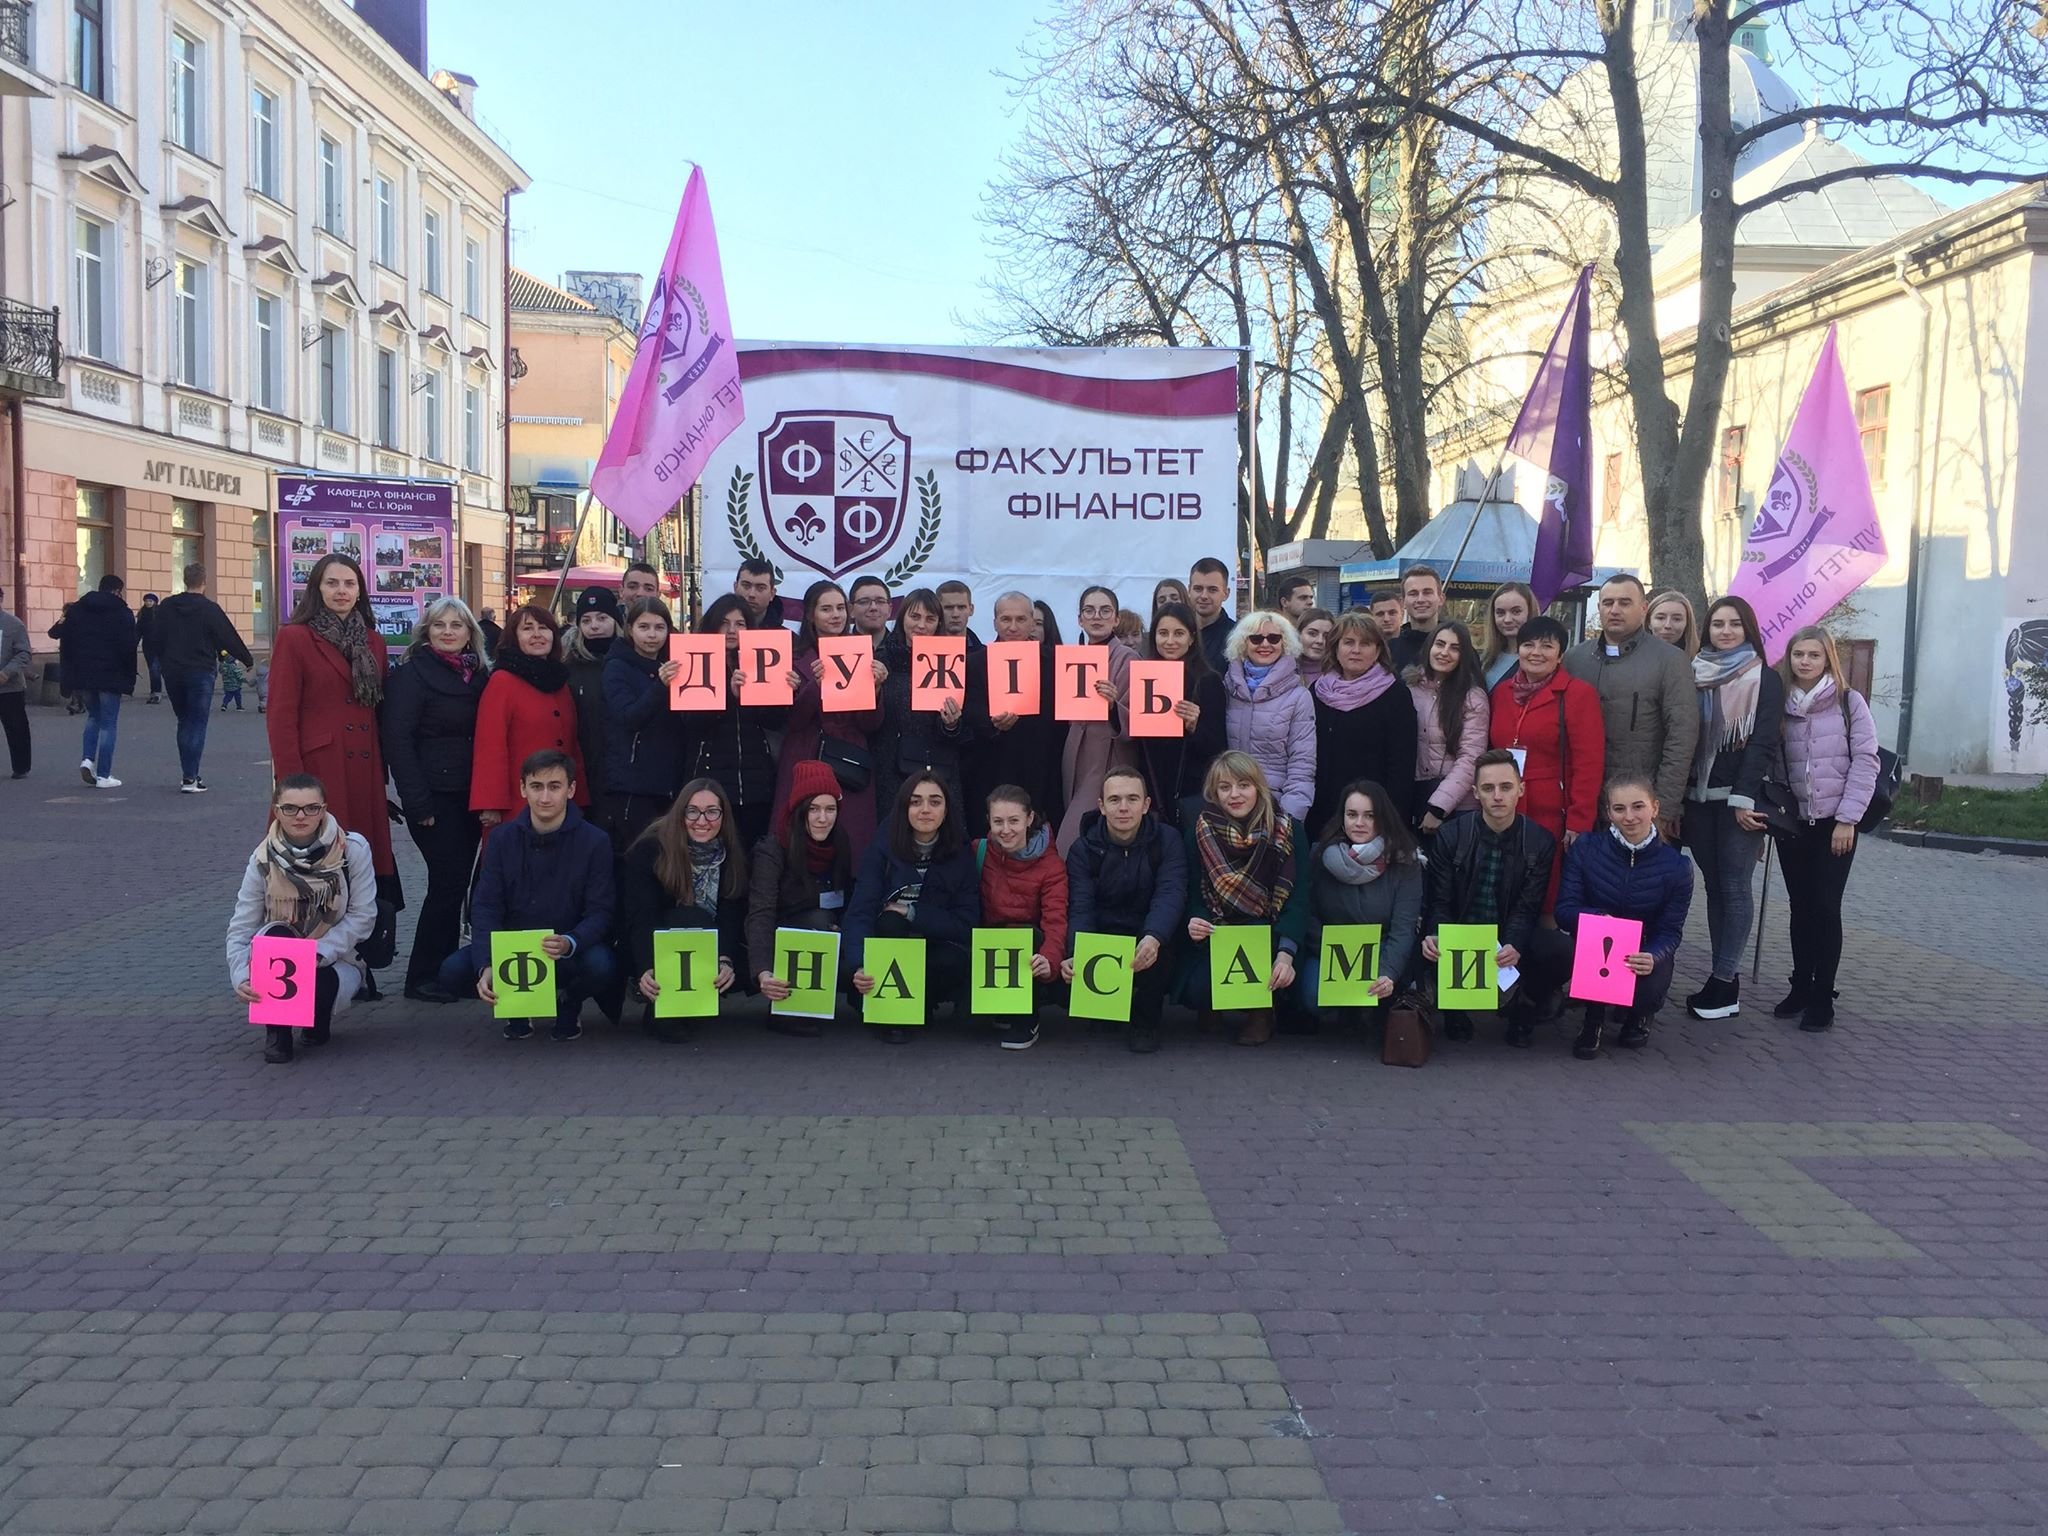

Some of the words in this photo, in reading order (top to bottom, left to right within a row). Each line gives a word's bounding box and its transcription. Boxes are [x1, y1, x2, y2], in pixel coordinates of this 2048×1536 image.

[955, 447, 1204, 475] ФАКУЛЬТЕТ
[144, 460, 175, 484] АРТ
[180, 465, 241, 496] ГАЛЕРЕЯ
[327, 487, 382, 499] КАФЕДРА
[384, 490, 437, 501] ФІНАНСІВ
[386, 501, 413, 512] Юрія
[1008, 492, 1202, 520] ФІНАНСІВ
